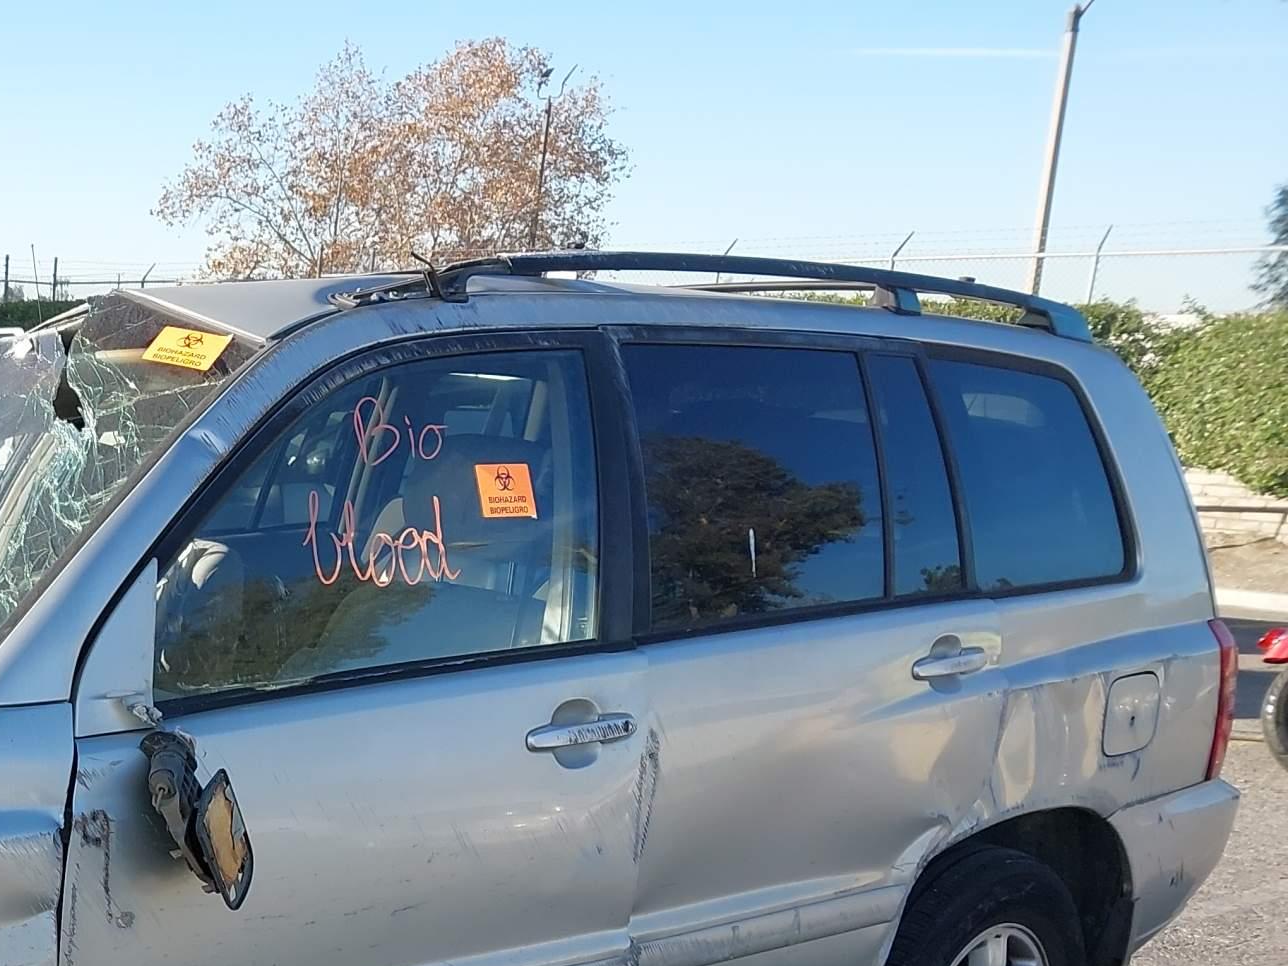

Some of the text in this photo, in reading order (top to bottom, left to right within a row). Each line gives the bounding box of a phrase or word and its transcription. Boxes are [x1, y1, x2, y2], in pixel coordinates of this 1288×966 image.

[152, 353, 202, 367] BIOPELIGRO
[156, 347, 207, 360] BIOHAZARD
[353, 396, 448, 466] Bio
[488, 495, 527, 504] BIOHAZARD
[489, 506, 529, 514] BIOPELIGRO
[302, 490, 461, 588] blood
